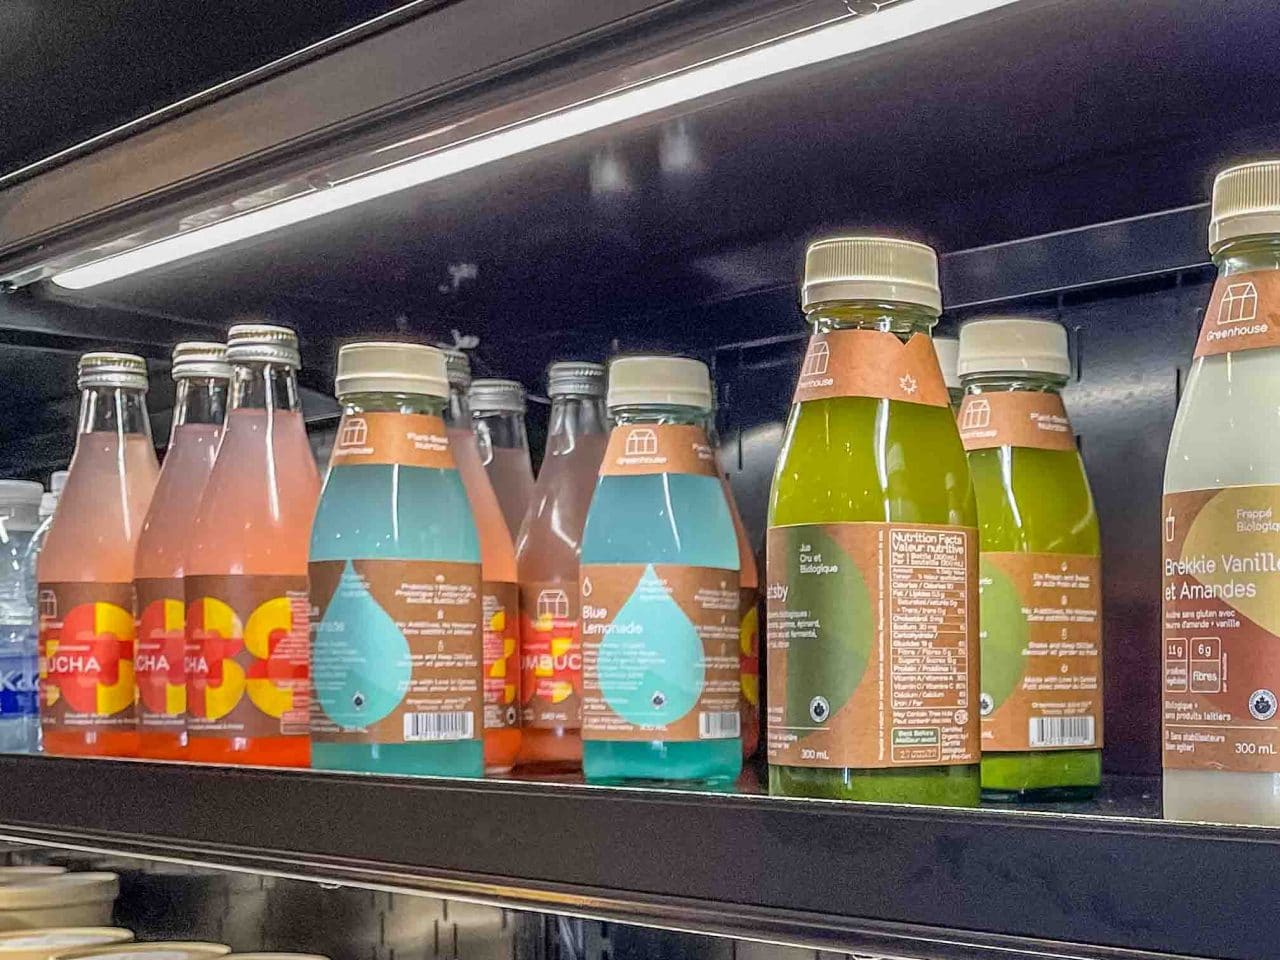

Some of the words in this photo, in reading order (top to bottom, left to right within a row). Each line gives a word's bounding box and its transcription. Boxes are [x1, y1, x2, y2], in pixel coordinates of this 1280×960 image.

[1207, 324, 1268, 341] Greenhouse
[1236, 508, 1272, 519] Frappé
[892, 532, 937, 543] Nutrition
[892, 541, 925, 552] Valeur
[927, 544, 964, 554] nutritive
[800, 564, 838, 574] Biologique
[1166, 555, 1215, 576] Brekkie
[1165, 582, 1176, 600] et
[1180, 580, 1257, 599] Amandes
[582, 605, 607, 619] Blue
[1219, 609, 1235, 617] avec
[582, 621, 643, 634] Lemonade
[1216, 619, 1240, 628] vanille
[1204, 711, 1231, 721] laitiers
[1235, 743, 1255, 754] 300
[1258, 743, 1277, 754] mL
[801, 750, 815, 759] 300
